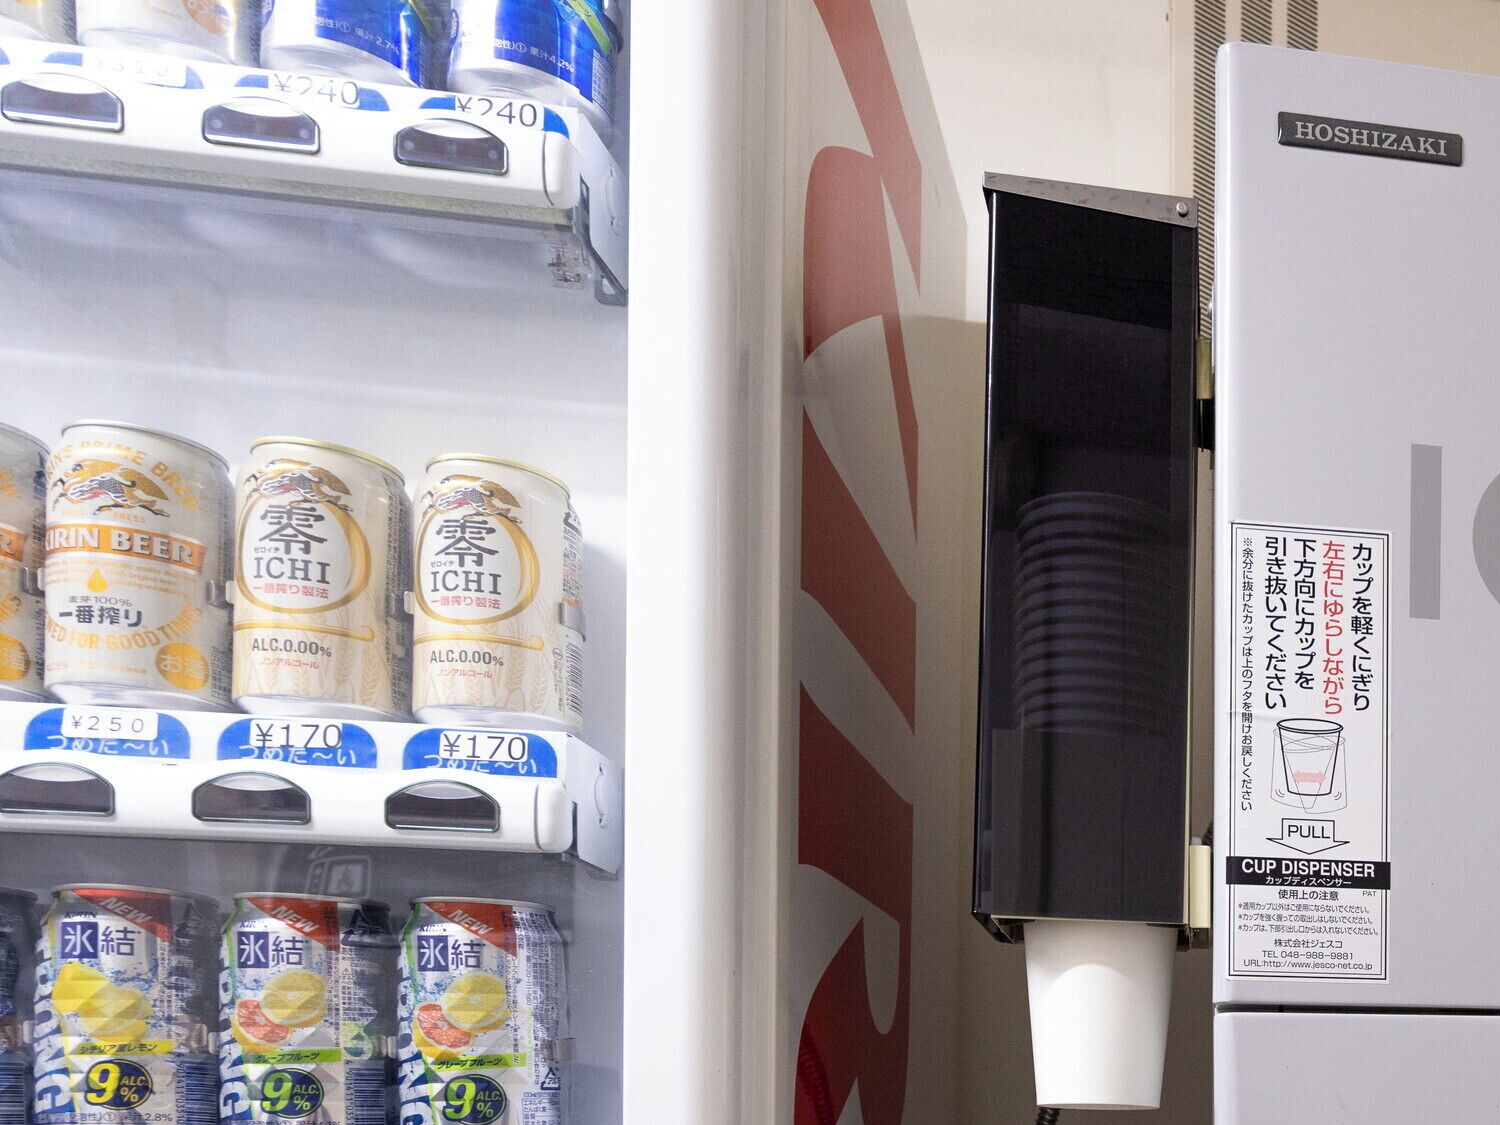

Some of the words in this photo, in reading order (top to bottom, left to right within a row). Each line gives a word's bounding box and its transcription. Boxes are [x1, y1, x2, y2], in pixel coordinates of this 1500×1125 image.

[457, 97, 537, 127] ¥240
[1295, 121, 1447, 157] HOSHIZAKI
[258, 504, 329, 555] 零
[47, 527, 99, 550] IRIN
[111, 529, 193, 565] BEER
[434, 518, 500, 568] 零
[254, 556, 331, 585] ICHI
[430, 570, 502, 596] ICHI
[253, 582, 330, 600] 一番搾り製法
[430, 594, 501, 610] 一番搾り製法
[59, 605, 143, 628] 一番搾り
[1264, 536, 1287, 710] 引き抜いてください
[1294, 537, 1317, 690] 下方向にカップを
[1322, 540, 1345, 714] 左右にゆらしながら
[1351, 543, 1374, 711] カップを軽くにぎり
[252, 638, 332, 658] ALC.0.00%
[430, 649, 504, 667] ALC.0.00%
[260, 657, 320, 669] ノンアルコール
[437, 668, 494, 679] ノンアルコール
[72, 715, 144, 733] ¥250
[255, 723, 342, 748] ¥170
[443, 733, 526, 761] ¥170
[1287, 825, 1330, 839] PULL
[1241, 858, 1278, 874] CUP
[1282, 861, 1375, 878] DISPENSER
[1265, 876, 1352, 887] カップディスペンサー
[1278, 889, 1339, 901] 使用上の注意
[100, 896, 152, 924] NEW
[270, 905, 320, 933] NEW
[448, 909, 494, 935] NEW
[63, 924, 136, 957] 氷結
[238, 935, 303, 966] 氷結
[420, 937, 482, 970] 氷結
[1274, 938, 1343, 949] 株式会社ジェスコ
[1262, 950, 1278, 958] TEL
[1281, 951, 1353, 960] 048-988-9881
[80, 1043, 157, 1056] シチリア産レモン
[255, 1052, 320, 1064] グレープフルーツ
[437, 1057, 503, 1070] グレープフルーツ
[86, 1062, 121, 1106] 9
[121, 1087, 138, 1102] %
[260, 1072, 292, 1116] 9
[294, 1095, 310, 1111] %
[445, 1079, 476, 1121] 9
[477, 1101, 494, 1118] %
